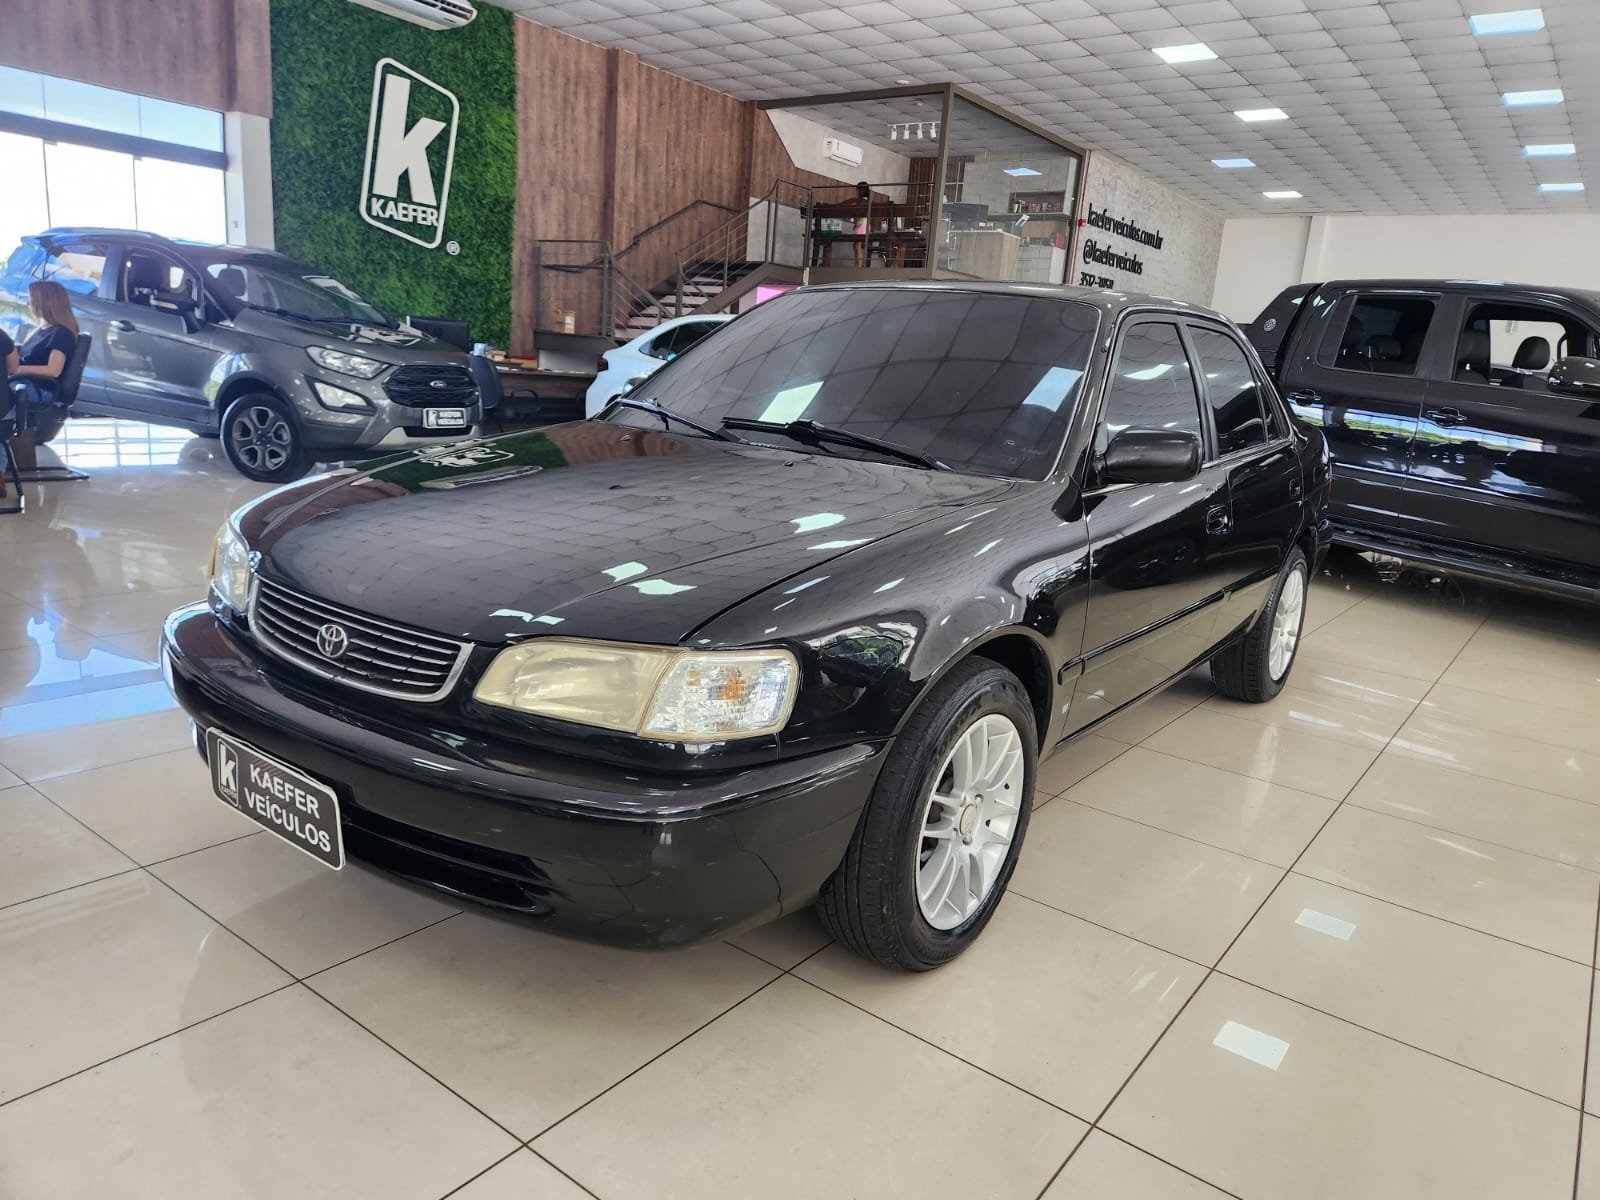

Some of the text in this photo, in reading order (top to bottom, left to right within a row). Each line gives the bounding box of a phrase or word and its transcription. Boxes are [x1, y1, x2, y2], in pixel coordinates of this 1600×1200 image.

[371, 197, 439, 227] KAEFER
[250, 763, 320, 819] KAEFER
[244, 786, 331, 853] VEÍCULOS
